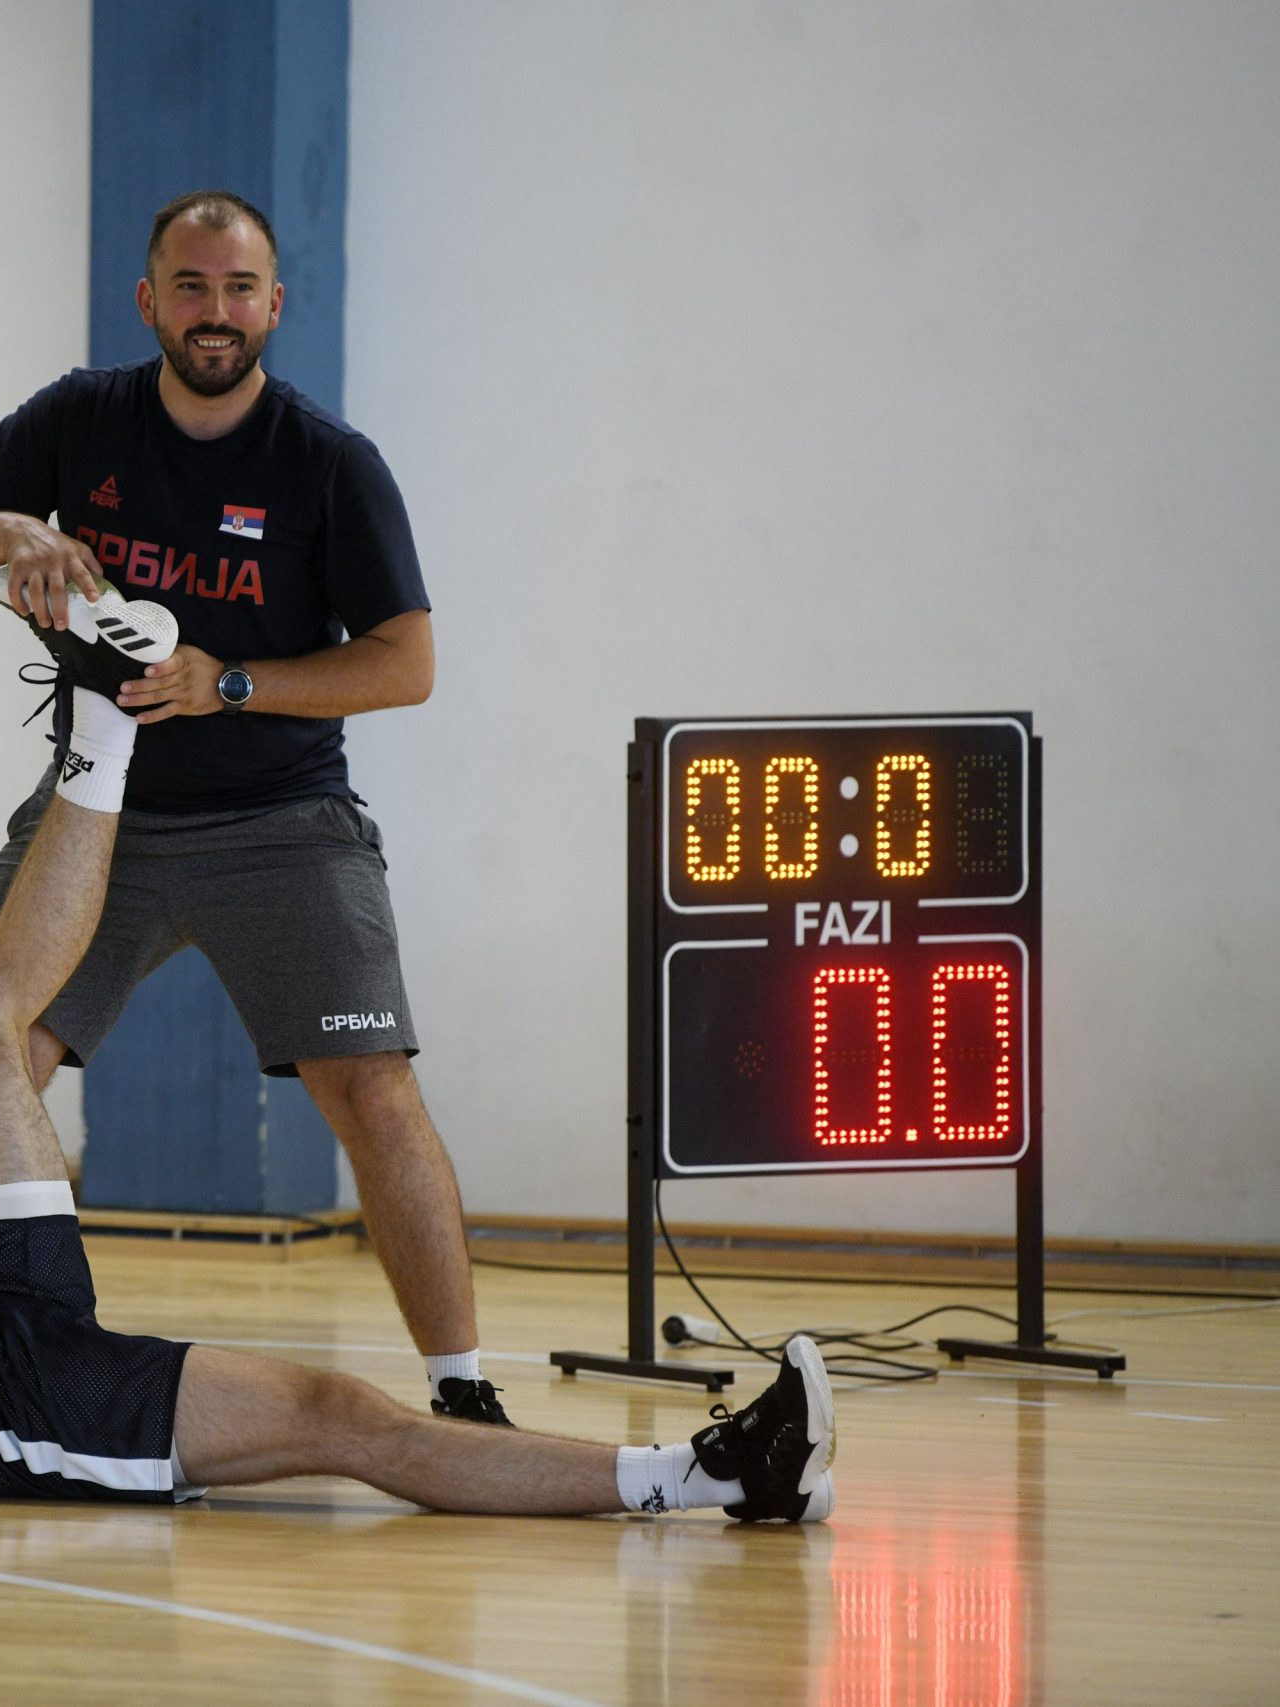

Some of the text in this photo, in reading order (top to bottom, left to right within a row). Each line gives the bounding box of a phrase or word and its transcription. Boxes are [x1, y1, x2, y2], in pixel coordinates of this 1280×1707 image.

[89, 490, 122, 511] PEAK
[67, 748, 95, 773] PEA
[795, 901, 891, 946] FAZI
[321, 1012, 396, 1031] СРБИЈА
[814, 965, 1009, 1145] 0.0
